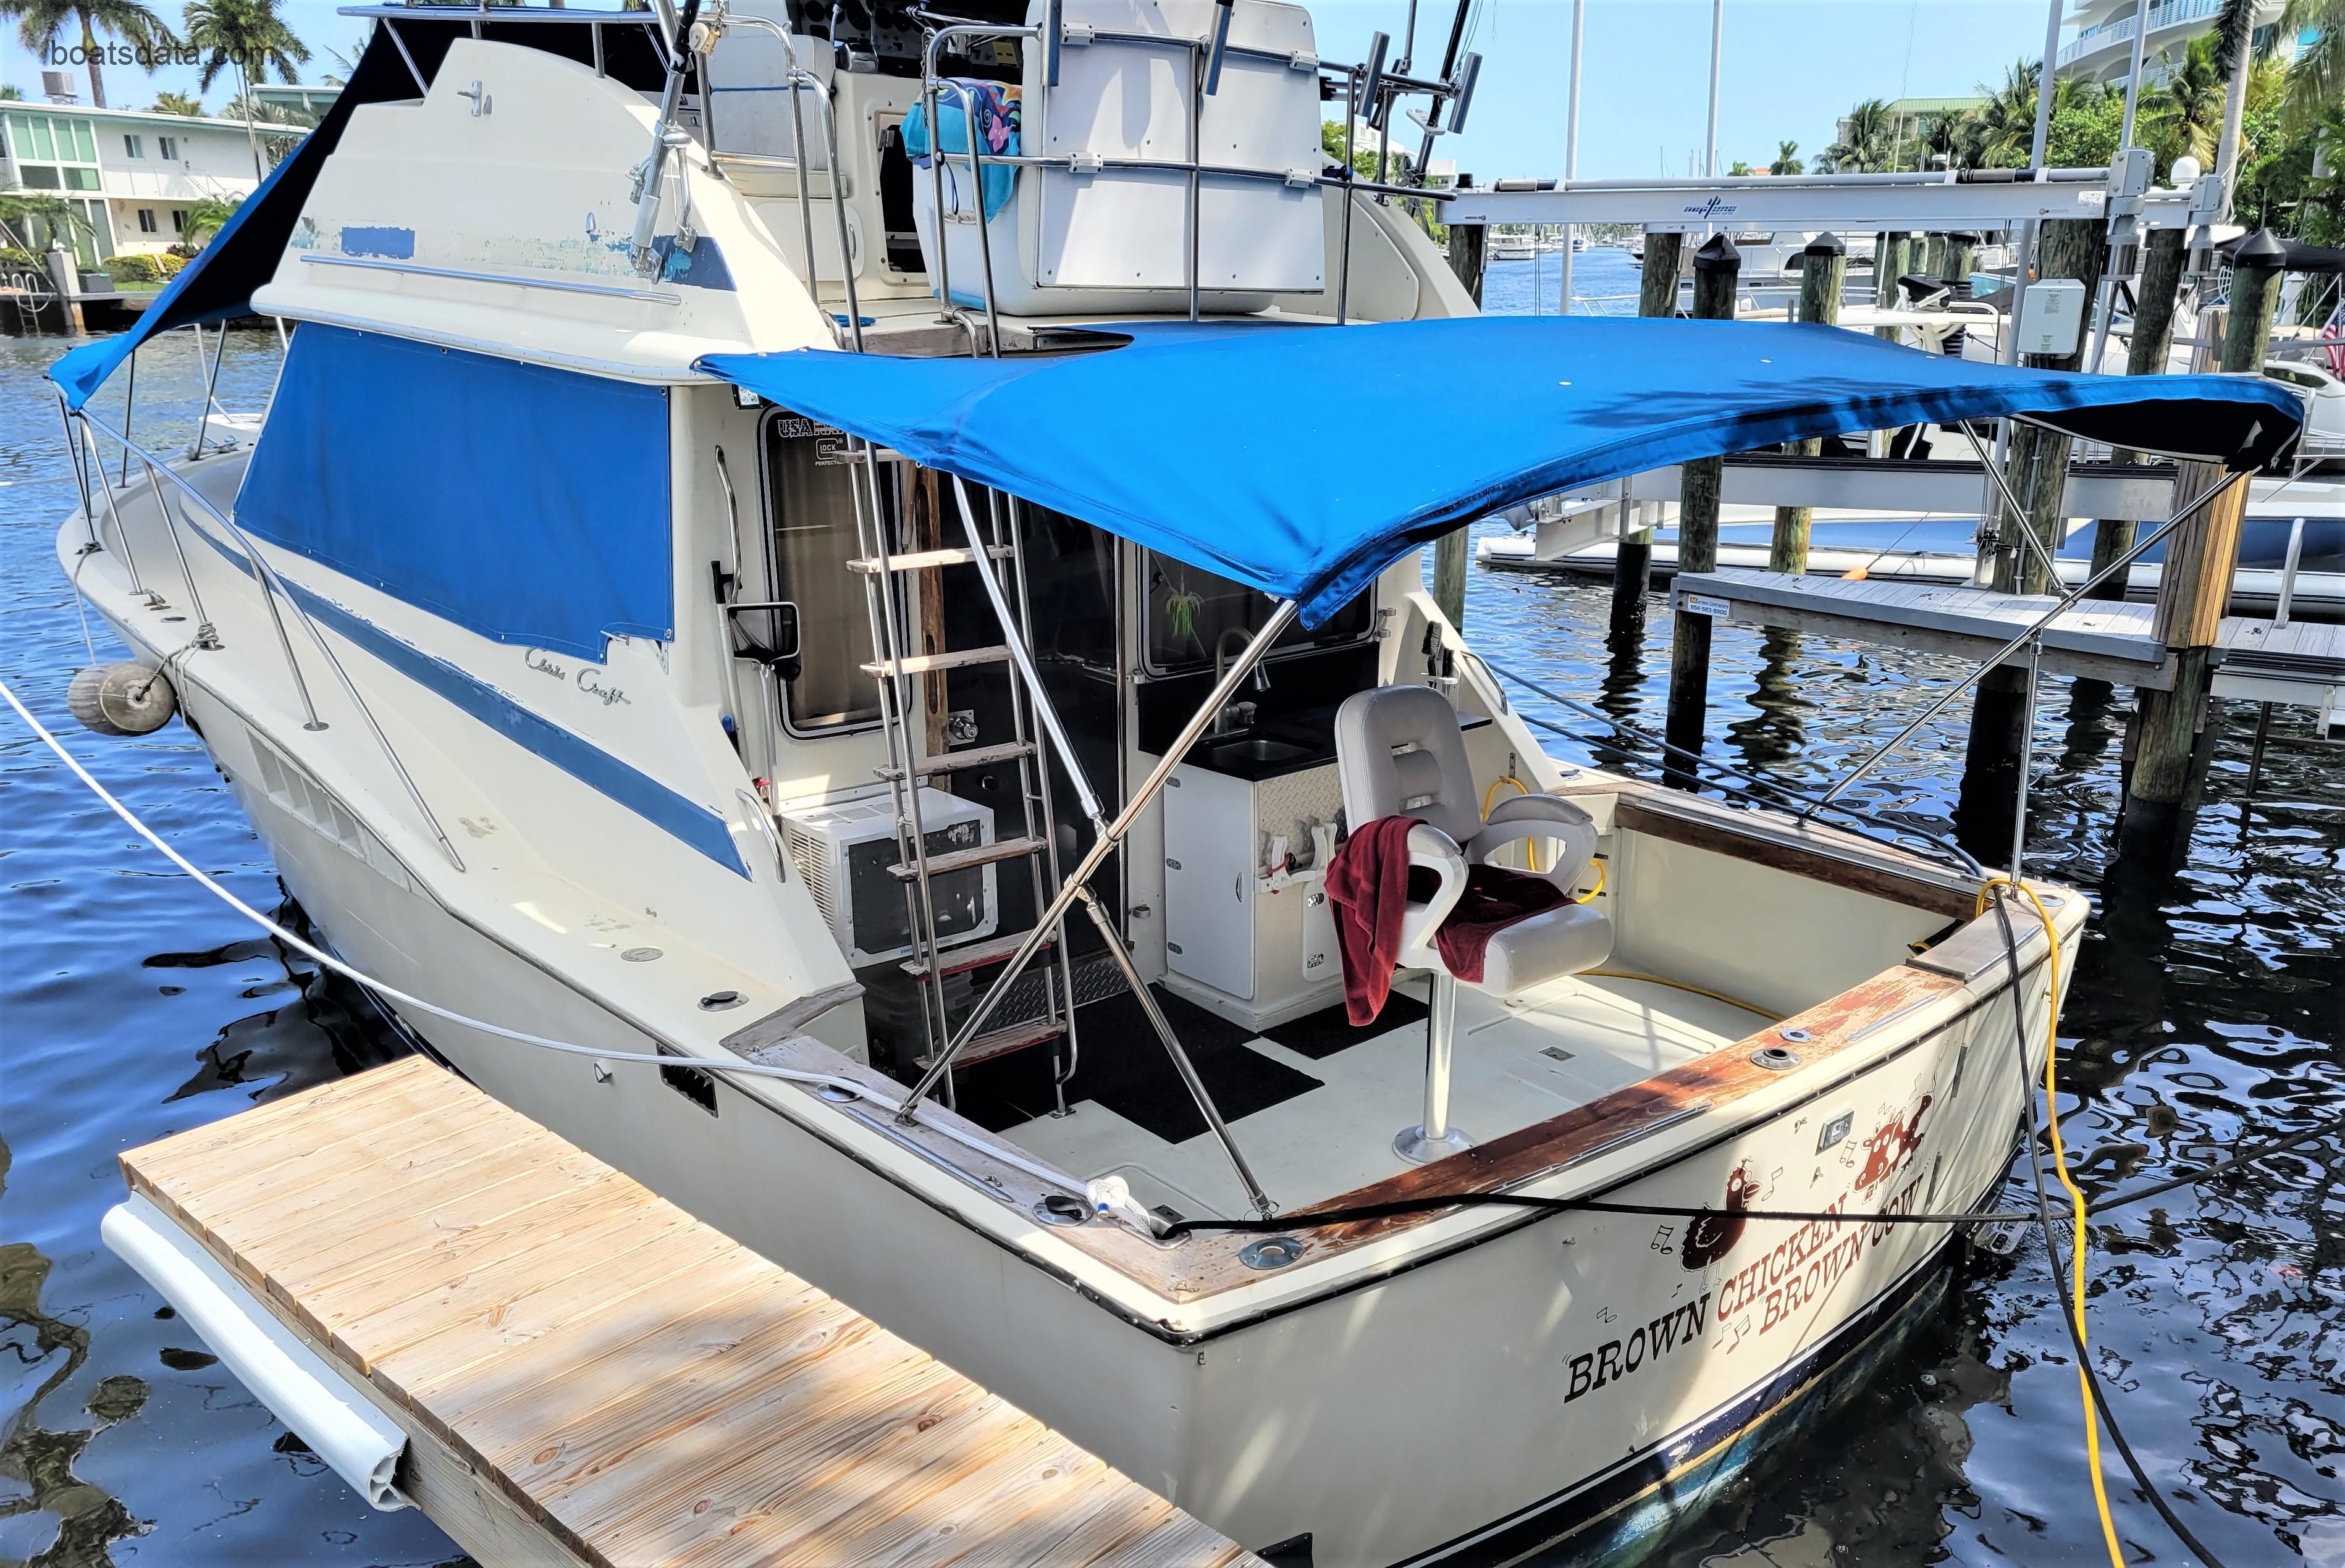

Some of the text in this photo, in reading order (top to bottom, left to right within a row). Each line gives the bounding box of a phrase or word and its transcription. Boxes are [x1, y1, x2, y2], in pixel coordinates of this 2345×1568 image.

[778, 418, 813, 438] USA
[576, 667, 632, 706] Craft
[1564, 1192, 1848, 1404] BROWN CHICKEN
[1759, 1173, 1924, 1336] BROWN COW
